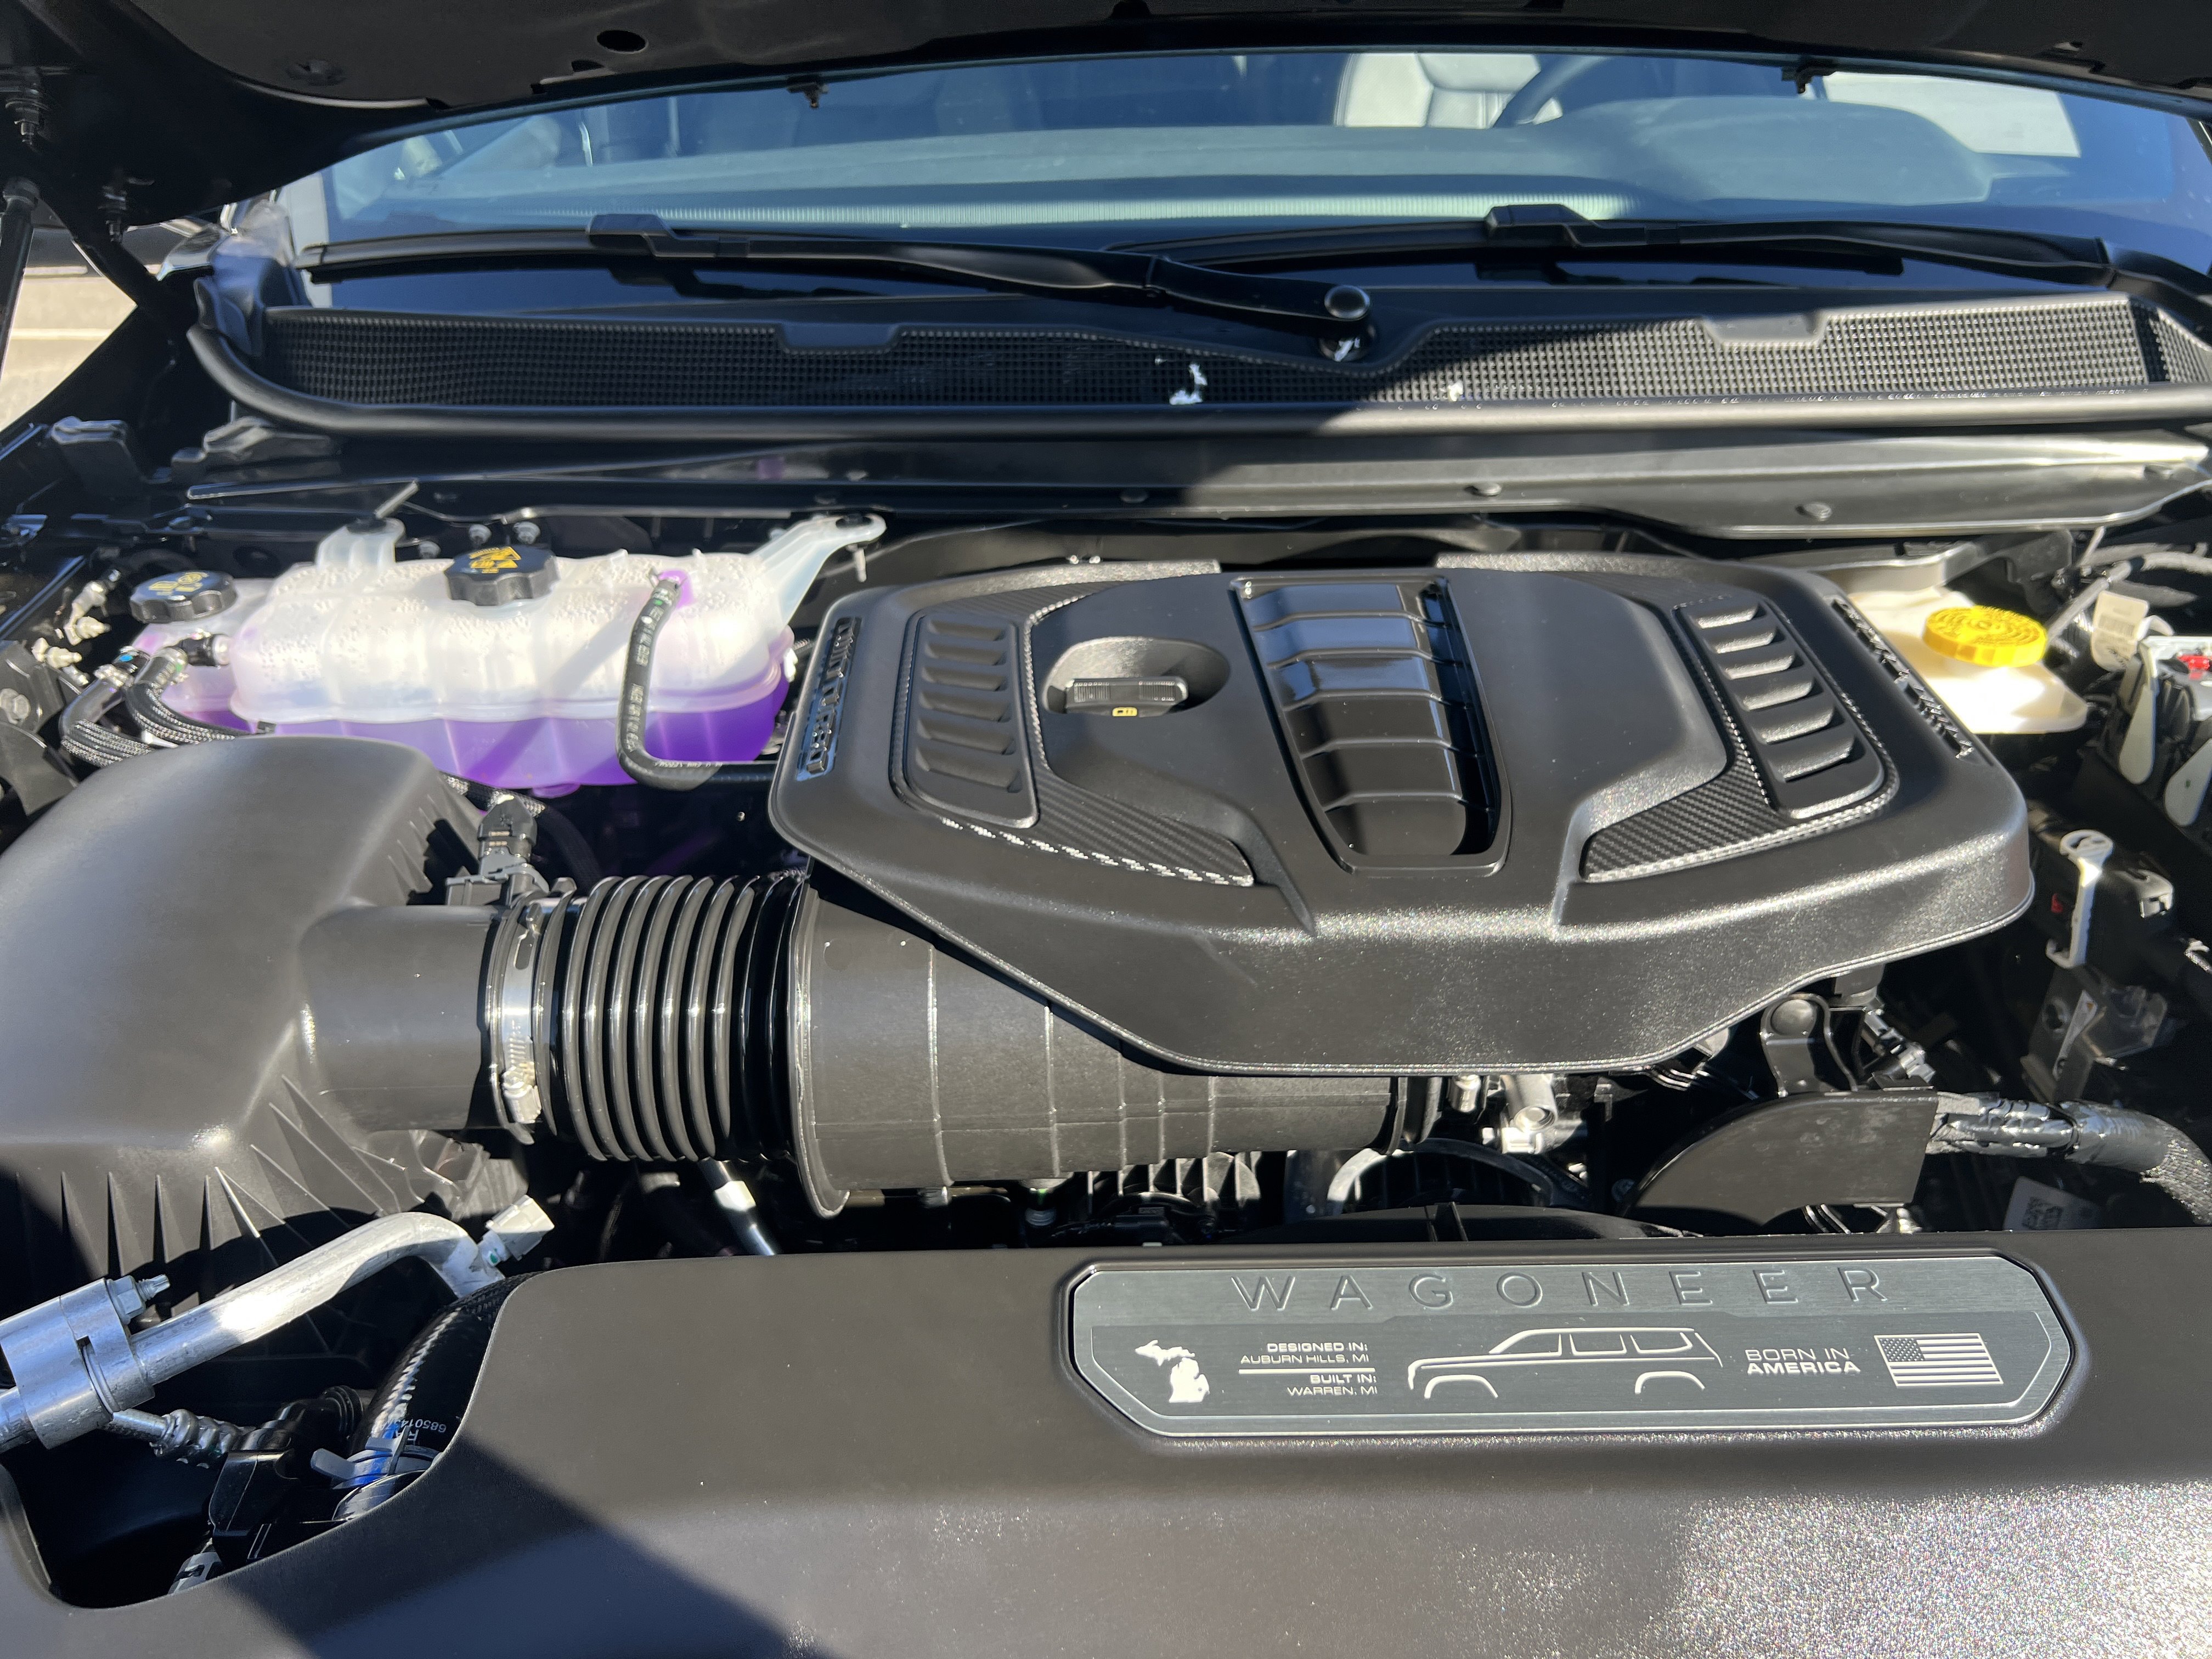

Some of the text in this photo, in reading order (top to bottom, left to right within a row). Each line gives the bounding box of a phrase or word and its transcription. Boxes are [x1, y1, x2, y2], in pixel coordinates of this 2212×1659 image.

[1231, 1266, 1888, 1311] WAGONEER
[1267, 1342, 1368, 1353] DESIGNED IN:
[1240, 1353, 1369, 1364] AUBURN HILLS, MI
[1745, 1347, 1850, 1361] BORN IN
[1747, 1361, 1861, 1375] AMERICA
[1310, 1373, 1377, 1384] BUILT IN:
[1287, 1386, 1378, 1396] WARREN, MI
